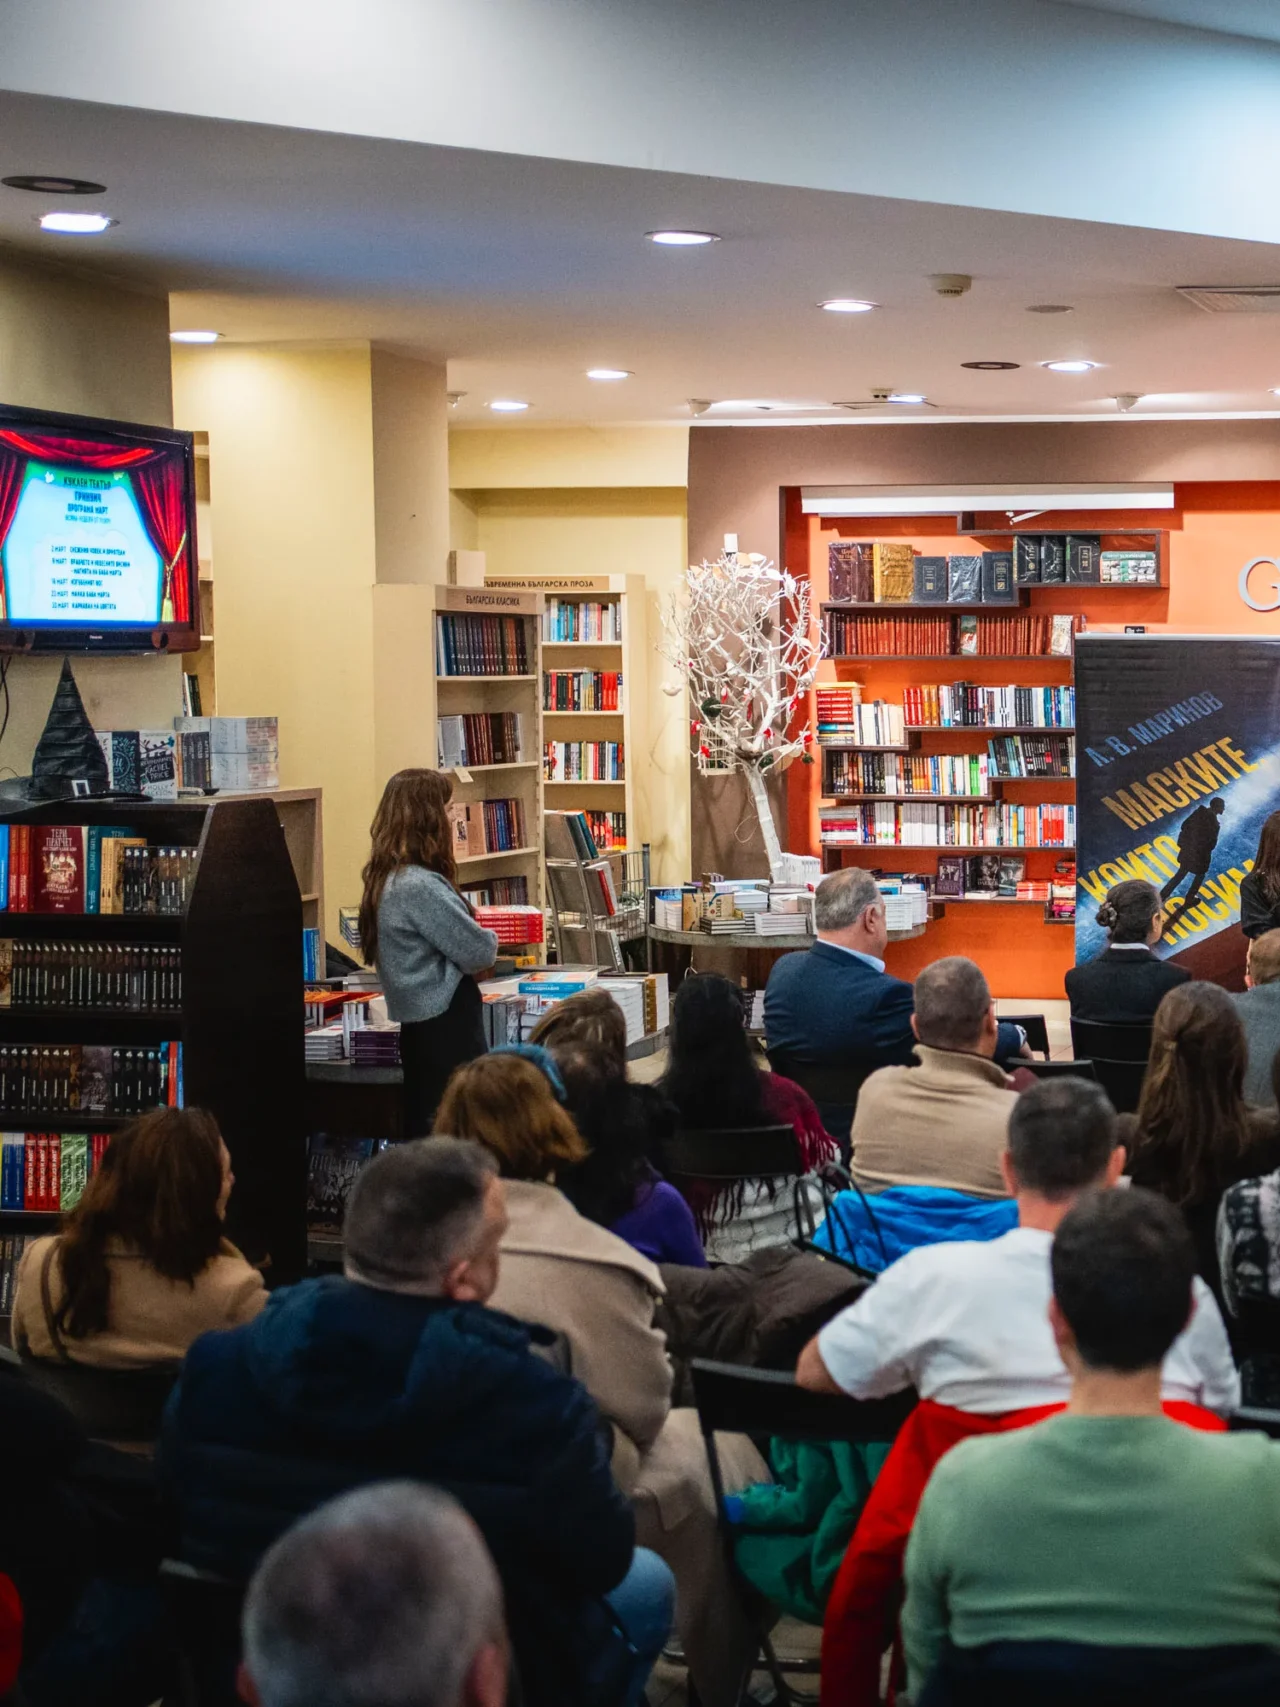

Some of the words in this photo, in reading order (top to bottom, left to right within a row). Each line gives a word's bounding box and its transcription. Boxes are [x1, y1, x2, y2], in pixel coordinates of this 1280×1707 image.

[63, 476, 88, 488] КУКЛЕН
[88, 478, 112, 490] ТЕАТЪР
[67, 503, 94, 513] ПРОГРАМА
[94, 506, 108, 514] МАРТ
[528, 580, 569, 588] БЪЛГАРСКА
[466, 594, 496, 605] БЪЛГАРСКА
[496, 596, 520, 606] КЛАСИКА
[1104, 735, 1138, 756] В.
[1127, 690, 1223, 746] МАРИНОВ
[51, 828, 68, 838] ТЕРИ
[46, 837, 72, 847] ПРАТЧЕТ
